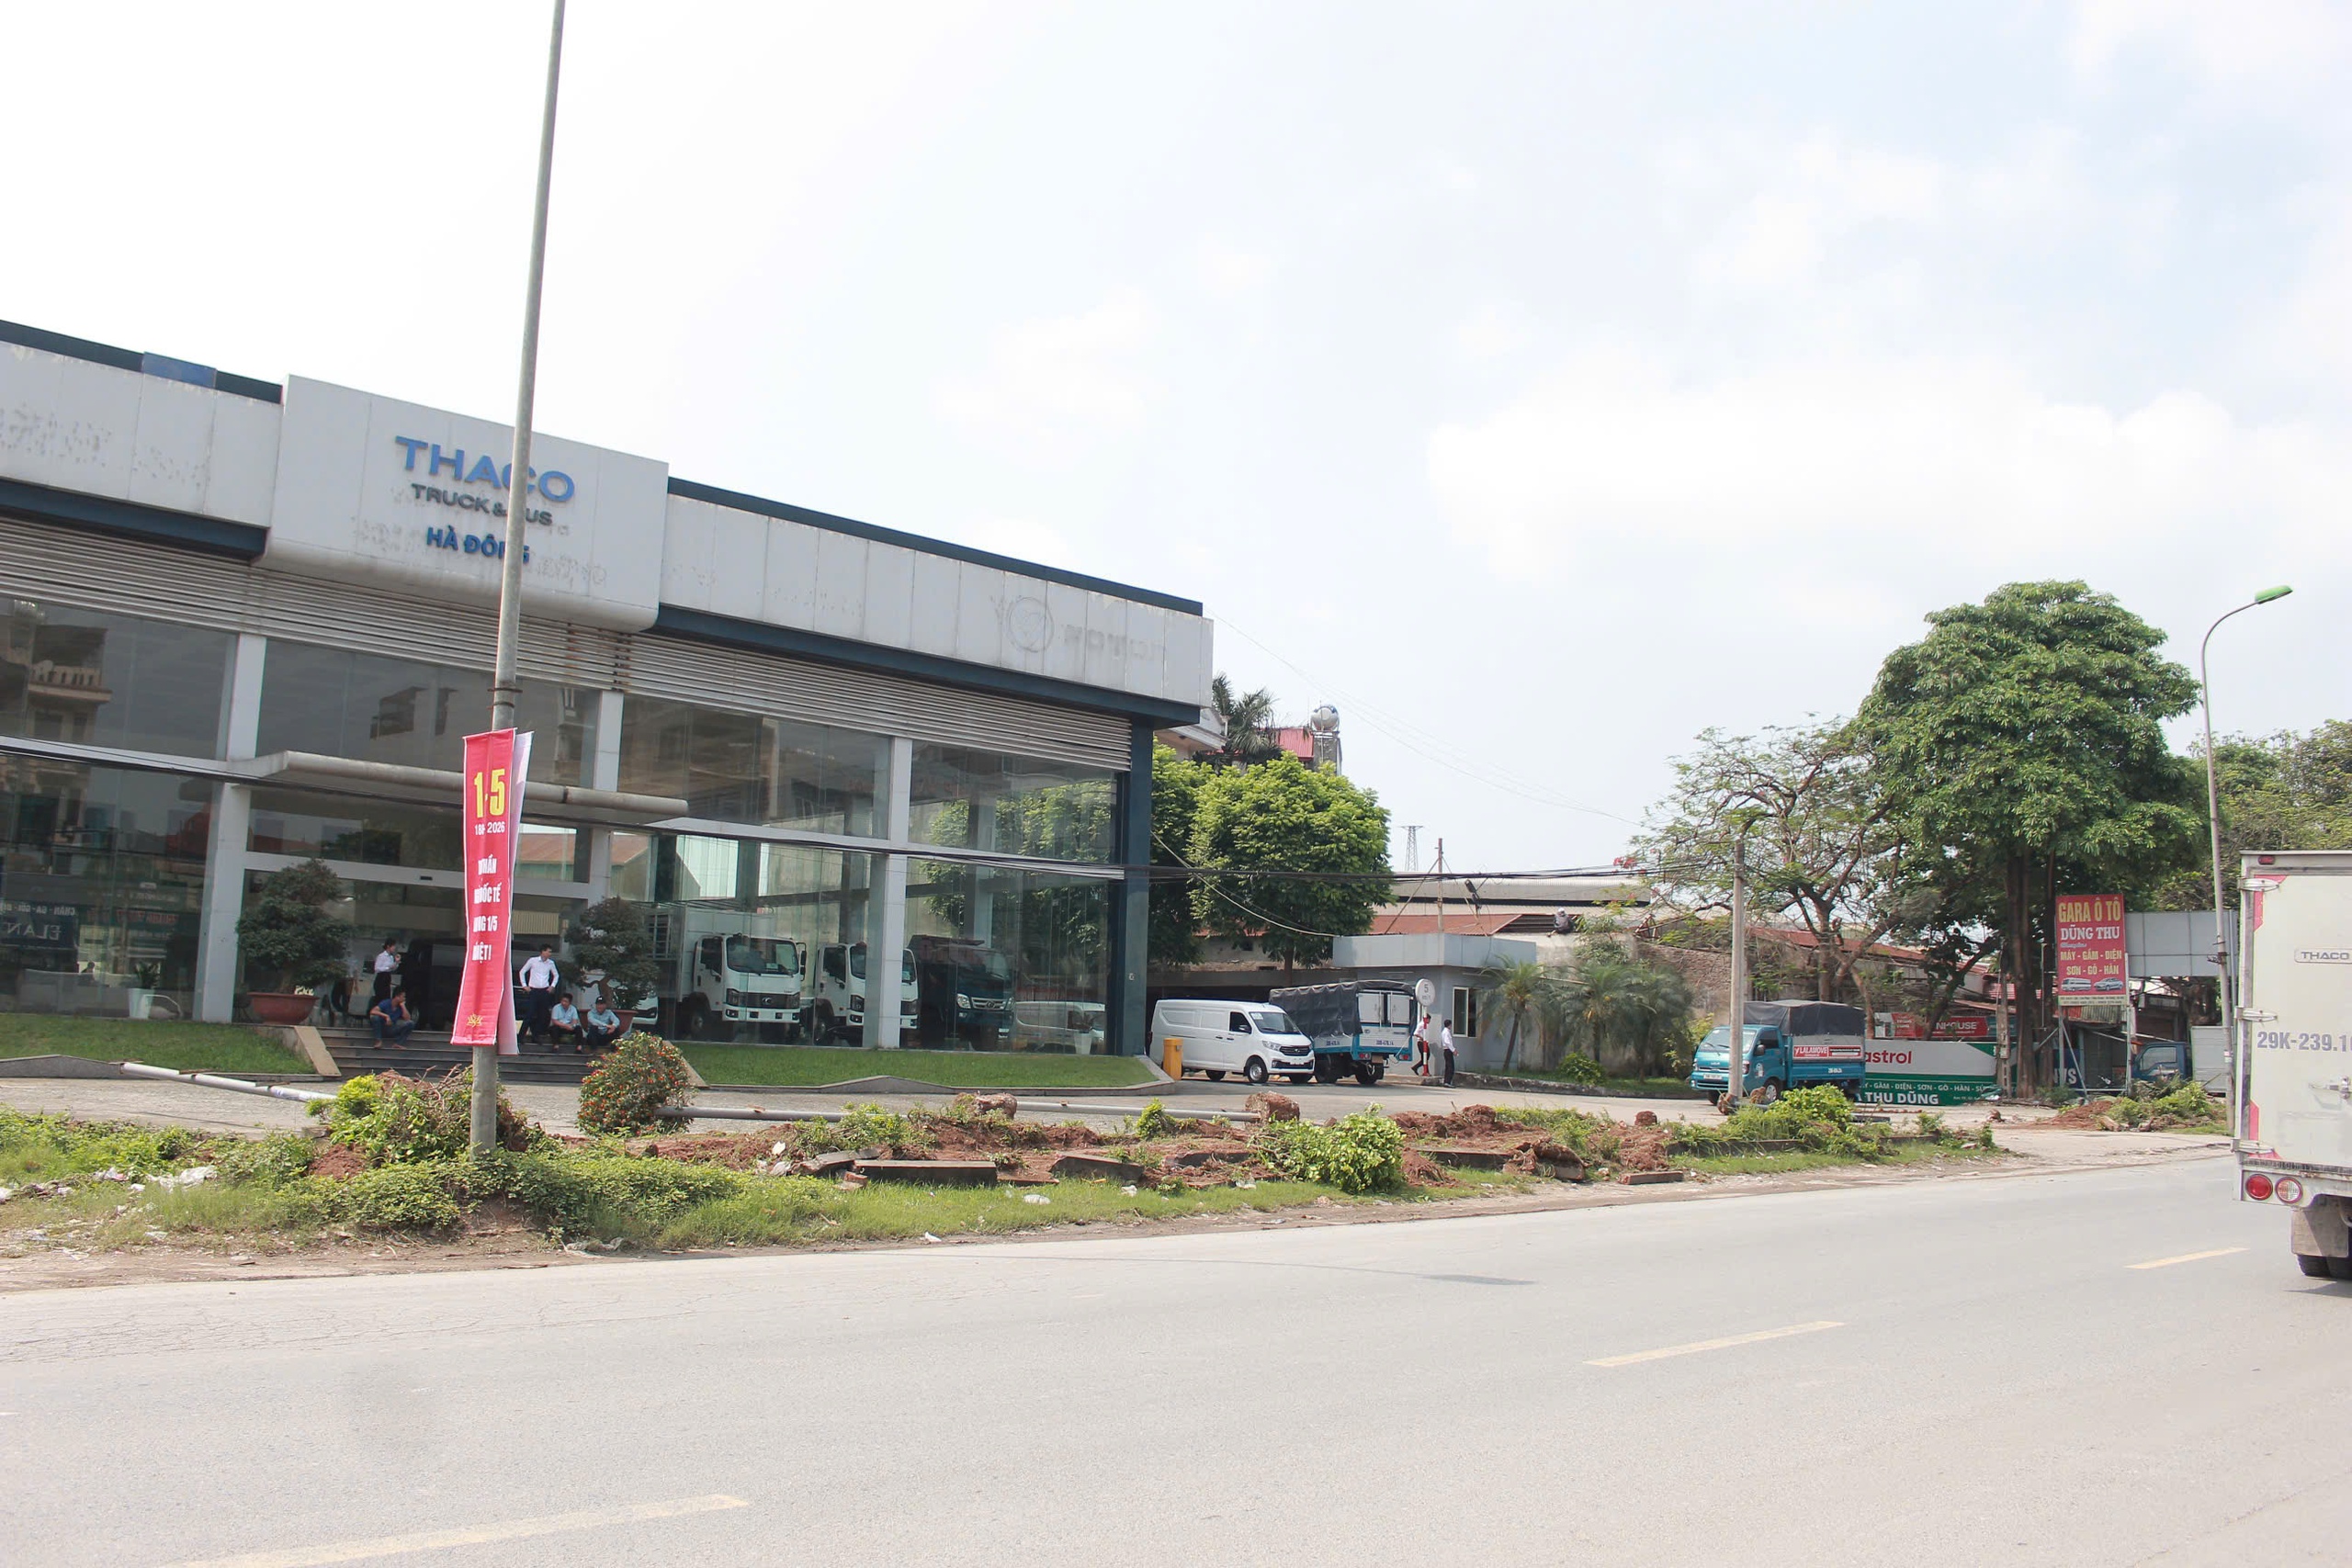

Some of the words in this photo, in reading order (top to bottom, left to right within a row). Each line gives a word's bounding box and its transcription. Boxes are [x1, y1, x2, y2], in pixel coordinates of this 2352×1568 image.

[412, 483, 491, 514] TRUCK
[526, 508, 552, 526] US
[426, 525, 459, 551] HÀ
[464, 534, 529, 564] ĐÔ
[2058, 901, 2091, 923] GARA
[2094, 897, 2103, 922] Ô
[2106, 897, 2121, 921] TÔ
[487, 915, 499, 931] 1/5
[2061, 924, 2094, 941] DŨNG
[2096, 926, 2120, 940] THU
[2301, 952, 2350, 961] THACO
[2256, 1031, 2352, 1053] 29K-239.1
[1865, 1050, 1912, 1064] astrol
[1864, 1091, 1893, 1103] THU
[1897, 1090, 1939, 1105] DŨNG
